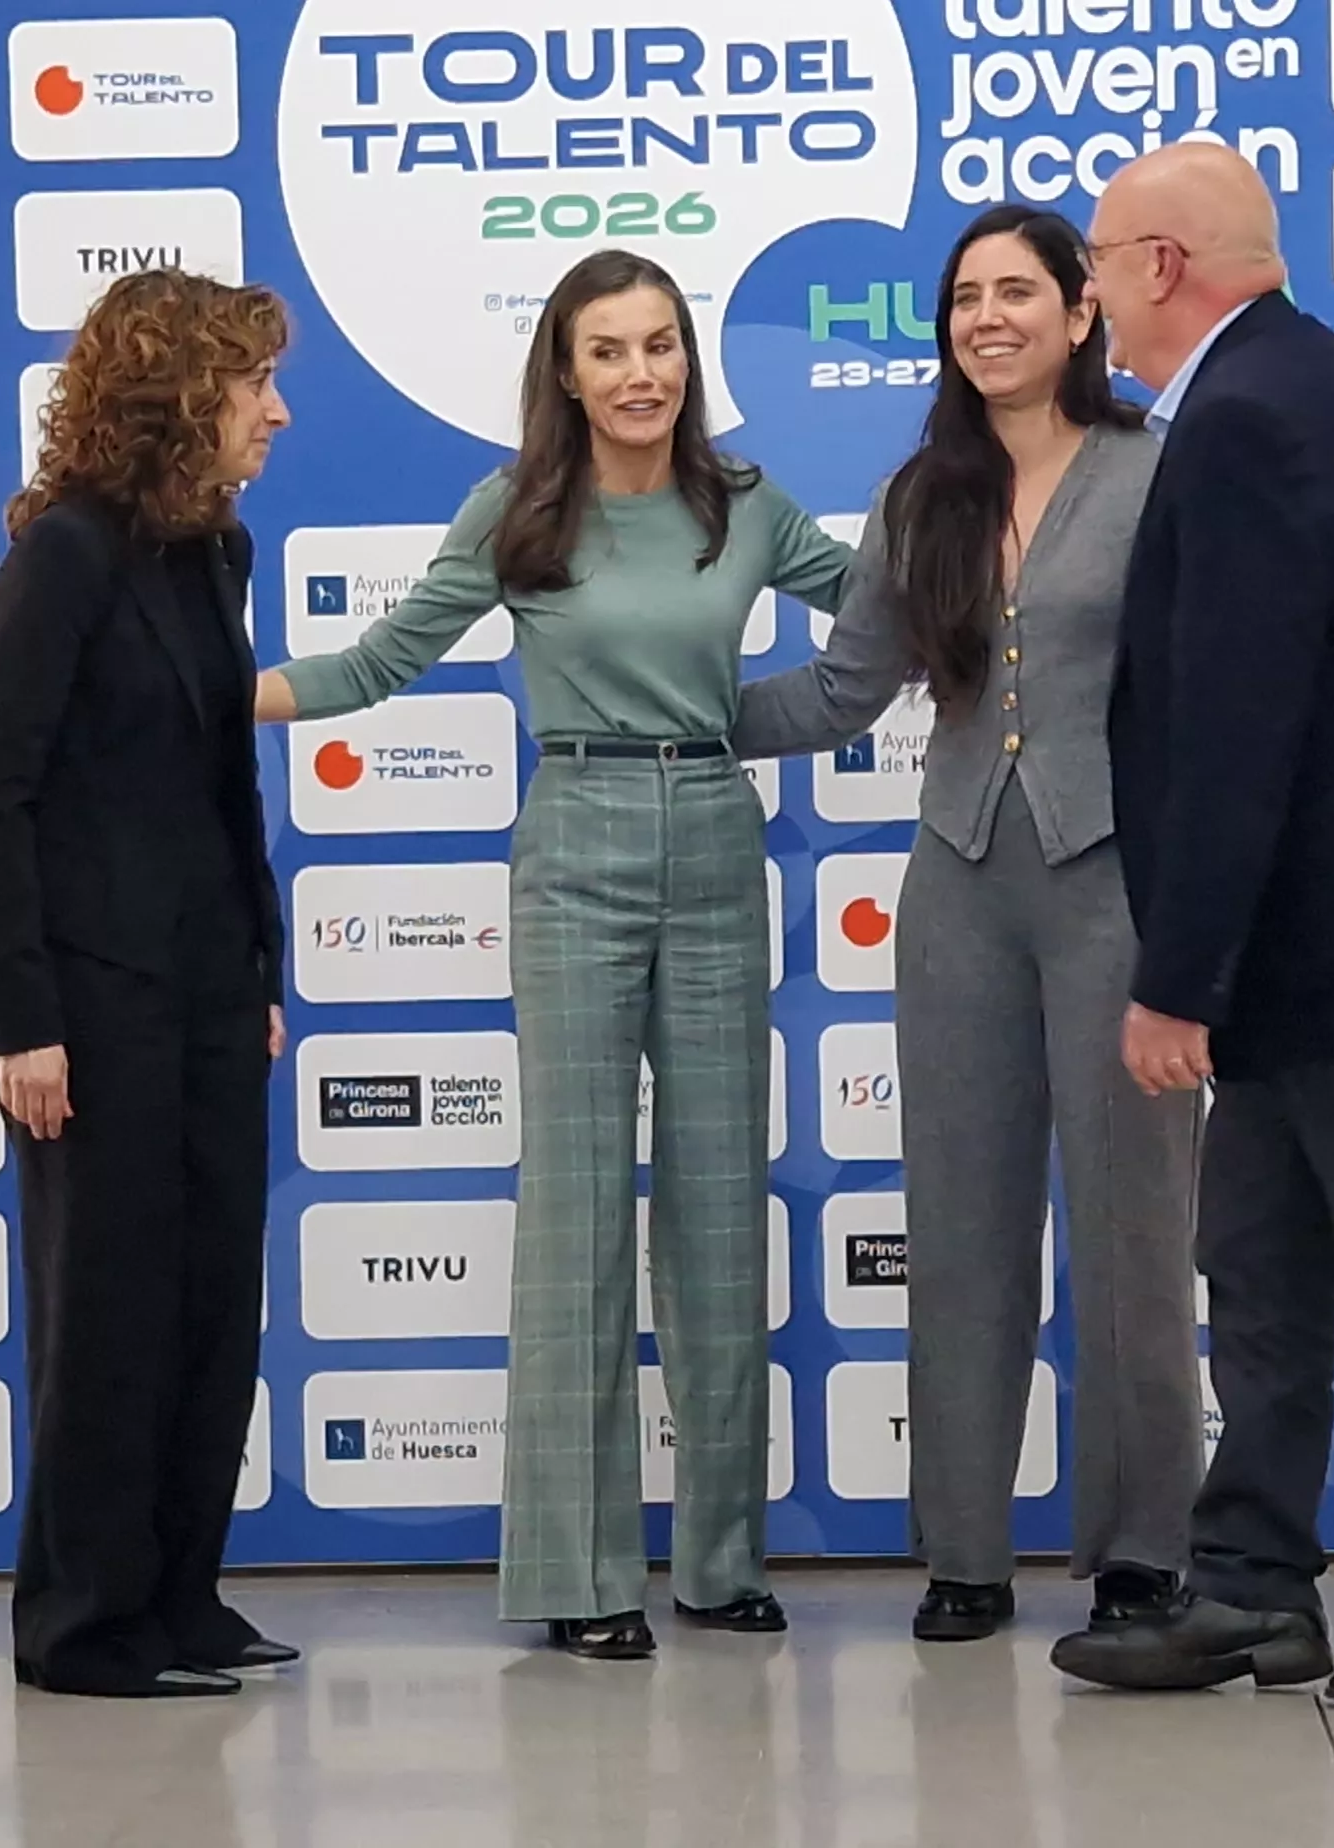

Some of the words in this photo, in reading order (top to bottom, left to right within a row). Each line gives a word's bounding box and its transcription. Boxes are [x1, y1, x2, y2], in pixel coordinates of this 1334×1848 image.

[319, 26, 706, 105] TOUR
[726, 39, 873, 96] DEL
[93, 73, 156, 87] TOUR
[941, 44, 1217, 138] joven
[1225, 37, 1299, 79] en
[93, 90, 214, 105] TALENTO
[320, 109, 877, 174] TALENTO
[481, 191, 717, 239] 2026
[78, 246, 182, 274] TRIVU
[810, 358, 940, 387] 23-27
[354, 601, 376, 616] de
[373, 749, 436, 762] TOUR
[881, 755, 905, 773] de
[373, 765, 494, 780] TALENTO
[312, 917, 365, 948] 150
[389, 930, 465, 949] Ibercaja
[328, 1082, 409, 1099] Princesa
[431, 1074, 502, 1093] talento
[838, 1074, 893, 1107] 150
[348, 1101, 410, 1119] Girona
[432, 1093, 486, 1113] joven
[362, 1256, 467, 1283] TRIVU
[372, 1443, 394, 1460] de
[402, 1441, 477, 1459] Huesca
